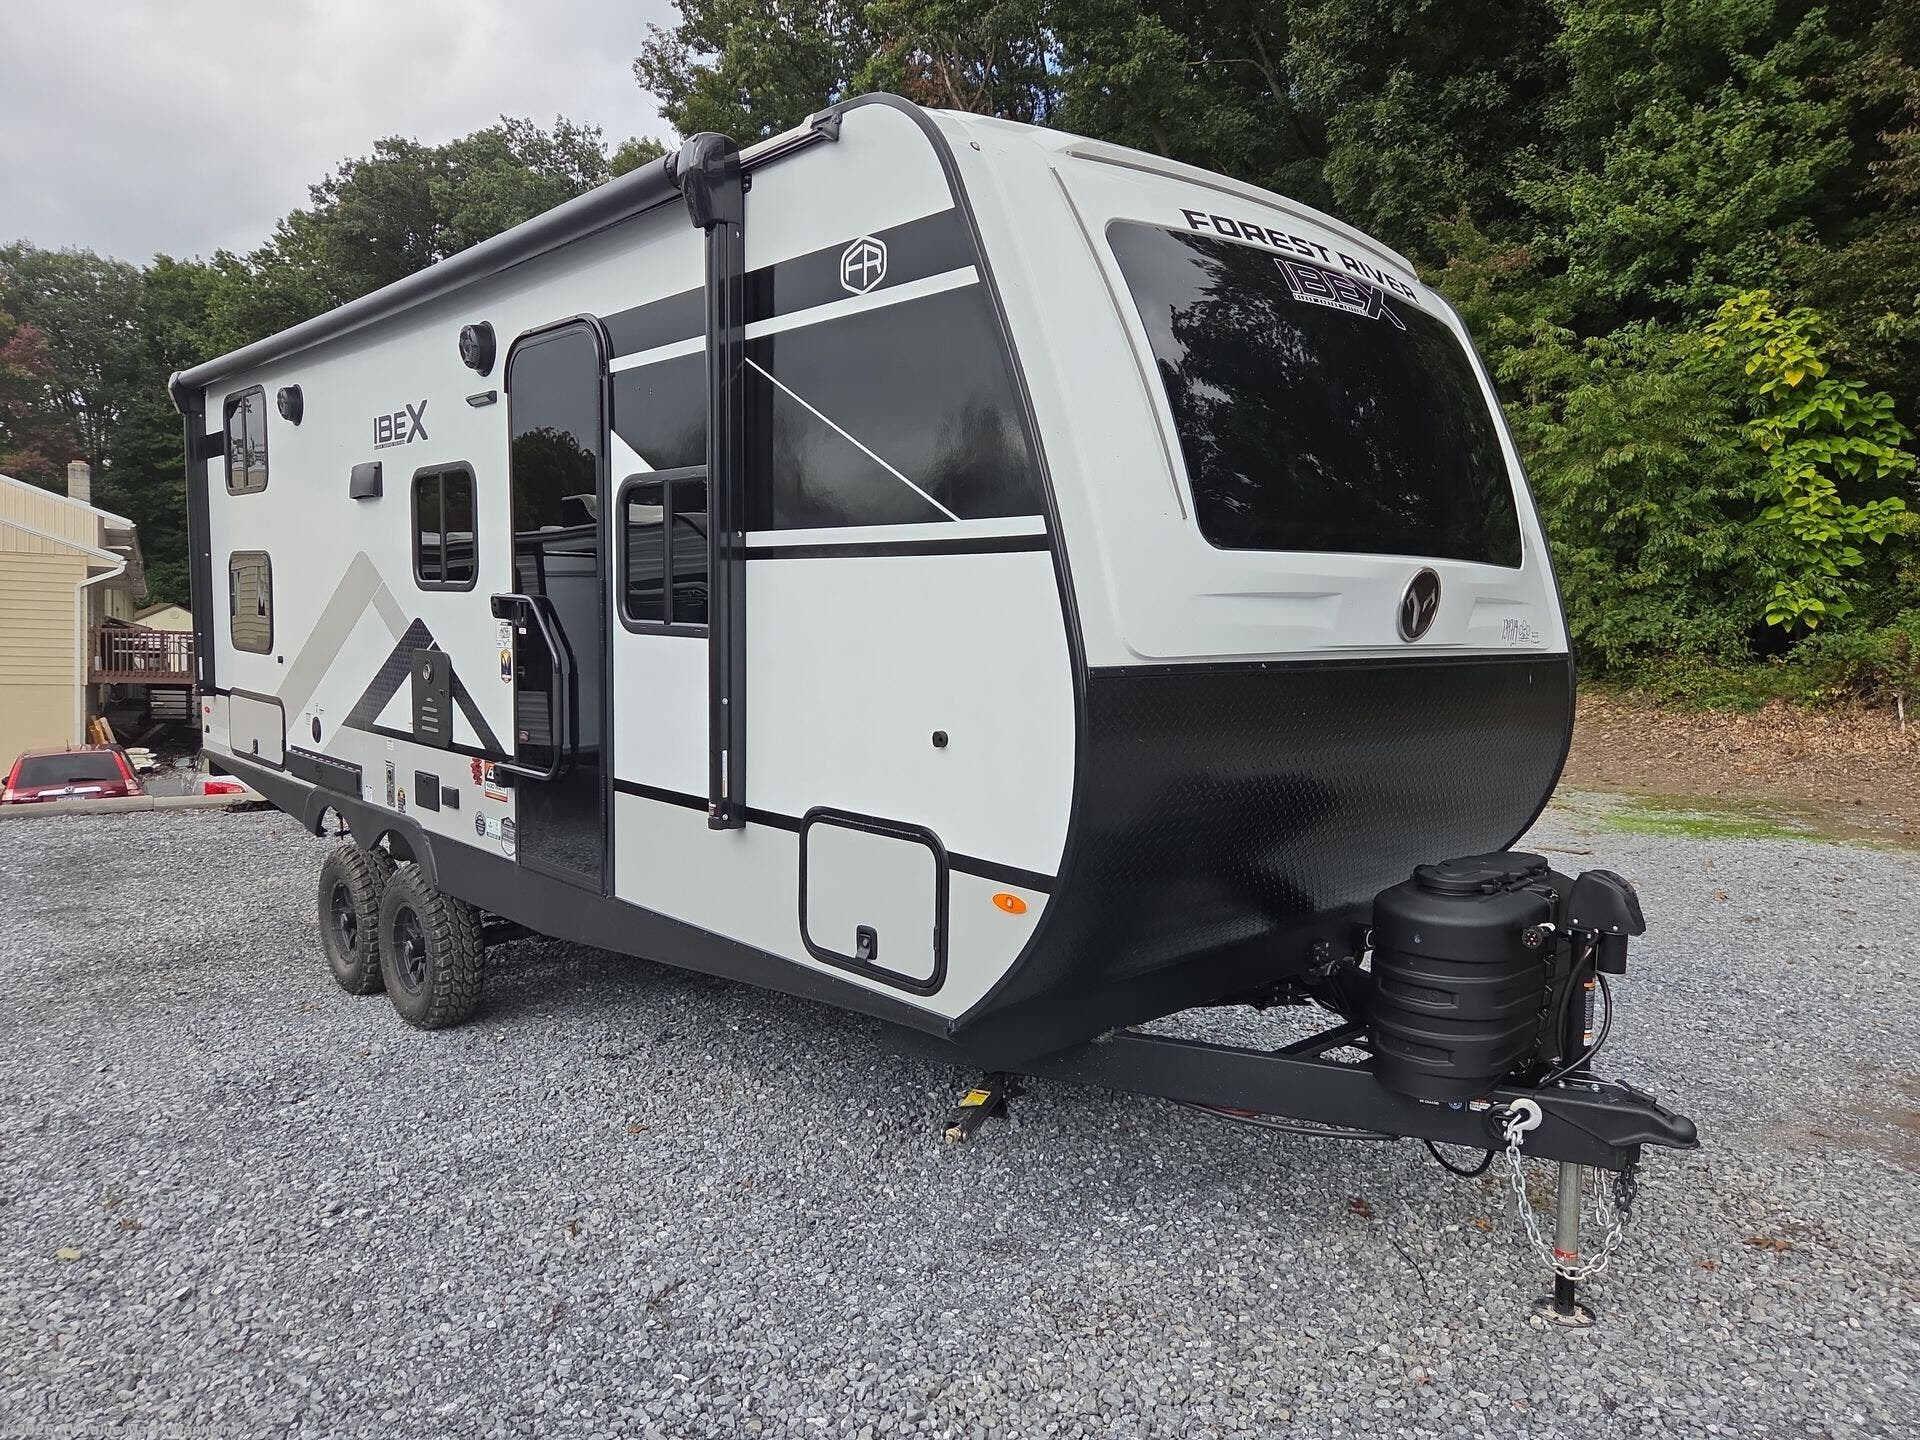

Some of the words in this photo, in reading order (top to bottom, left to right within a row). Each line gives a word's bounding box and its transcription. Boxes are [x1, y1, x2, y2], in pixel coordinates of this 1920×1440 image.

[1179, 208, 1331, 263] FOREST
[1335, 251, 1420, 304] RIVER
[1273, 257, 1406, 331] IBEX
[373, 399, 428, 443] IBEX
